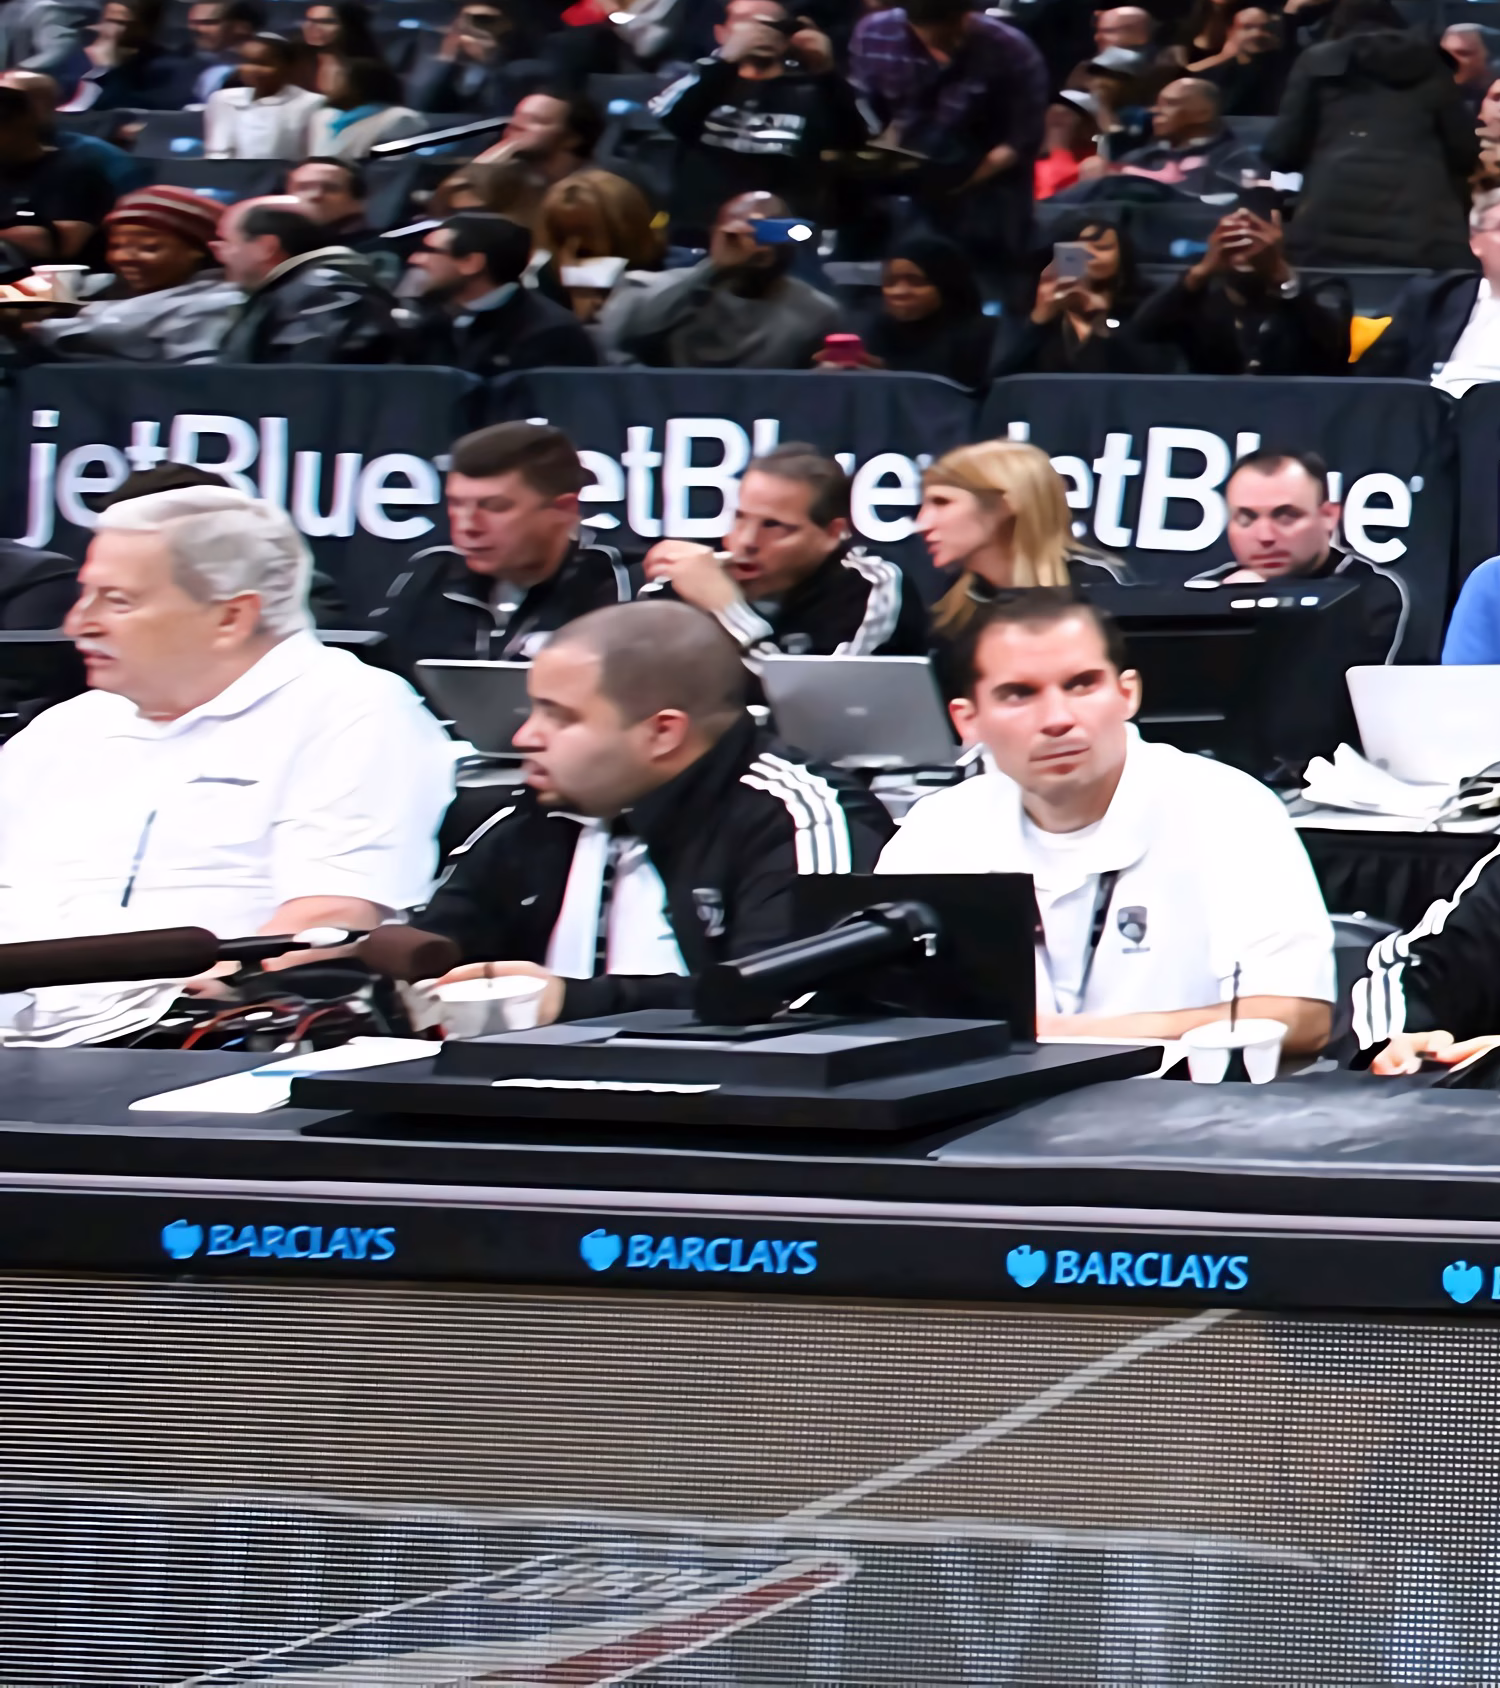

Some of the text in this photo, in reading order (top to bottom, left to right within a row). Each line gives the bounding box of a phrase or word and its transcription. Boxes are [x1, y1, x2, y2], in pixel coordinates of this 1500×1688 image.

[207, 1223, 396, 1261] BARCLAYS
[626, 1234, 818, 1274] BARCLAYS
[1054, 1249, 1249, 1291] BARCLAYS
